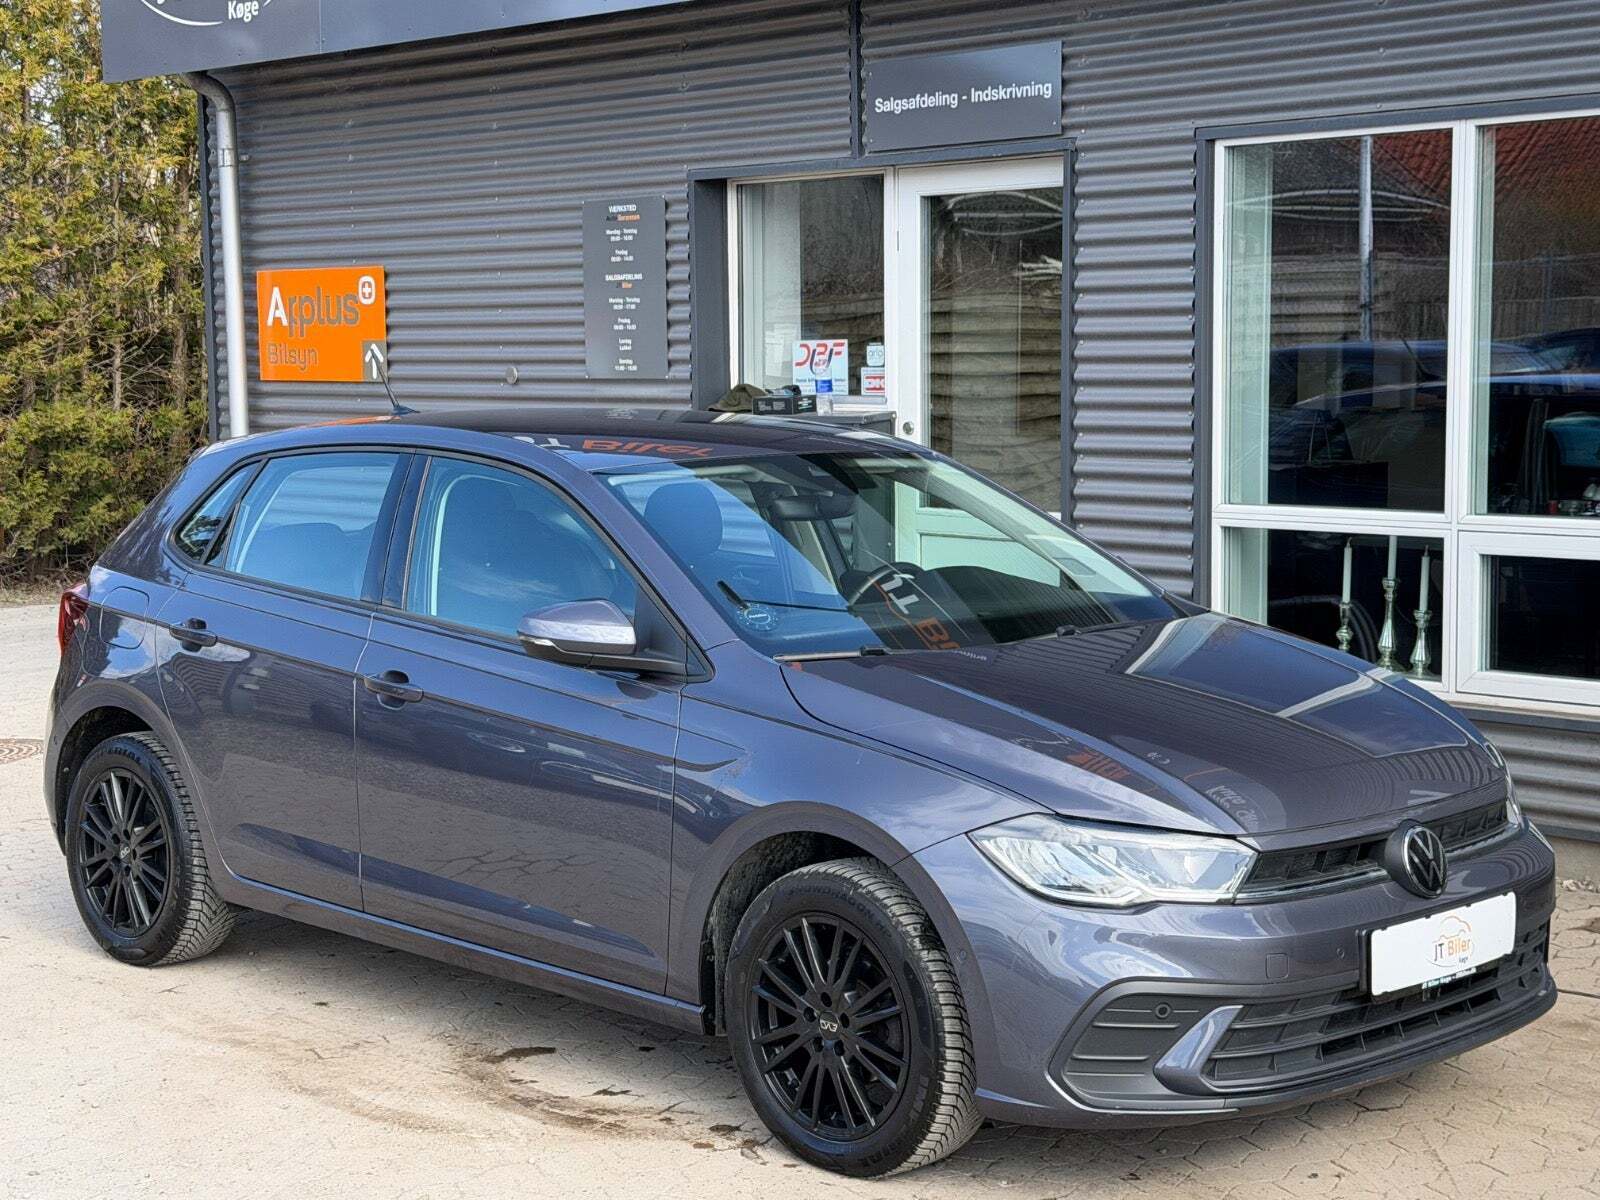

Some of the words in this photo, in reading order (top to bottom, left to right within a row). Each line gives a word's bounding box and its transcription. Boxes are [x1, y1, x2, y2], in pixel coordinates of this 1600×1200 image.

[228, 0, 259, 22] Køge
[874, 91, 959, 114] Salgsafdeling
[970, 81, 1053, 103] Indskrivning
[268, 343, 318, 371] Bilsyn
[1433, 942, 1445, 962] JT
[1447, 938, 1471, 957] Biler
